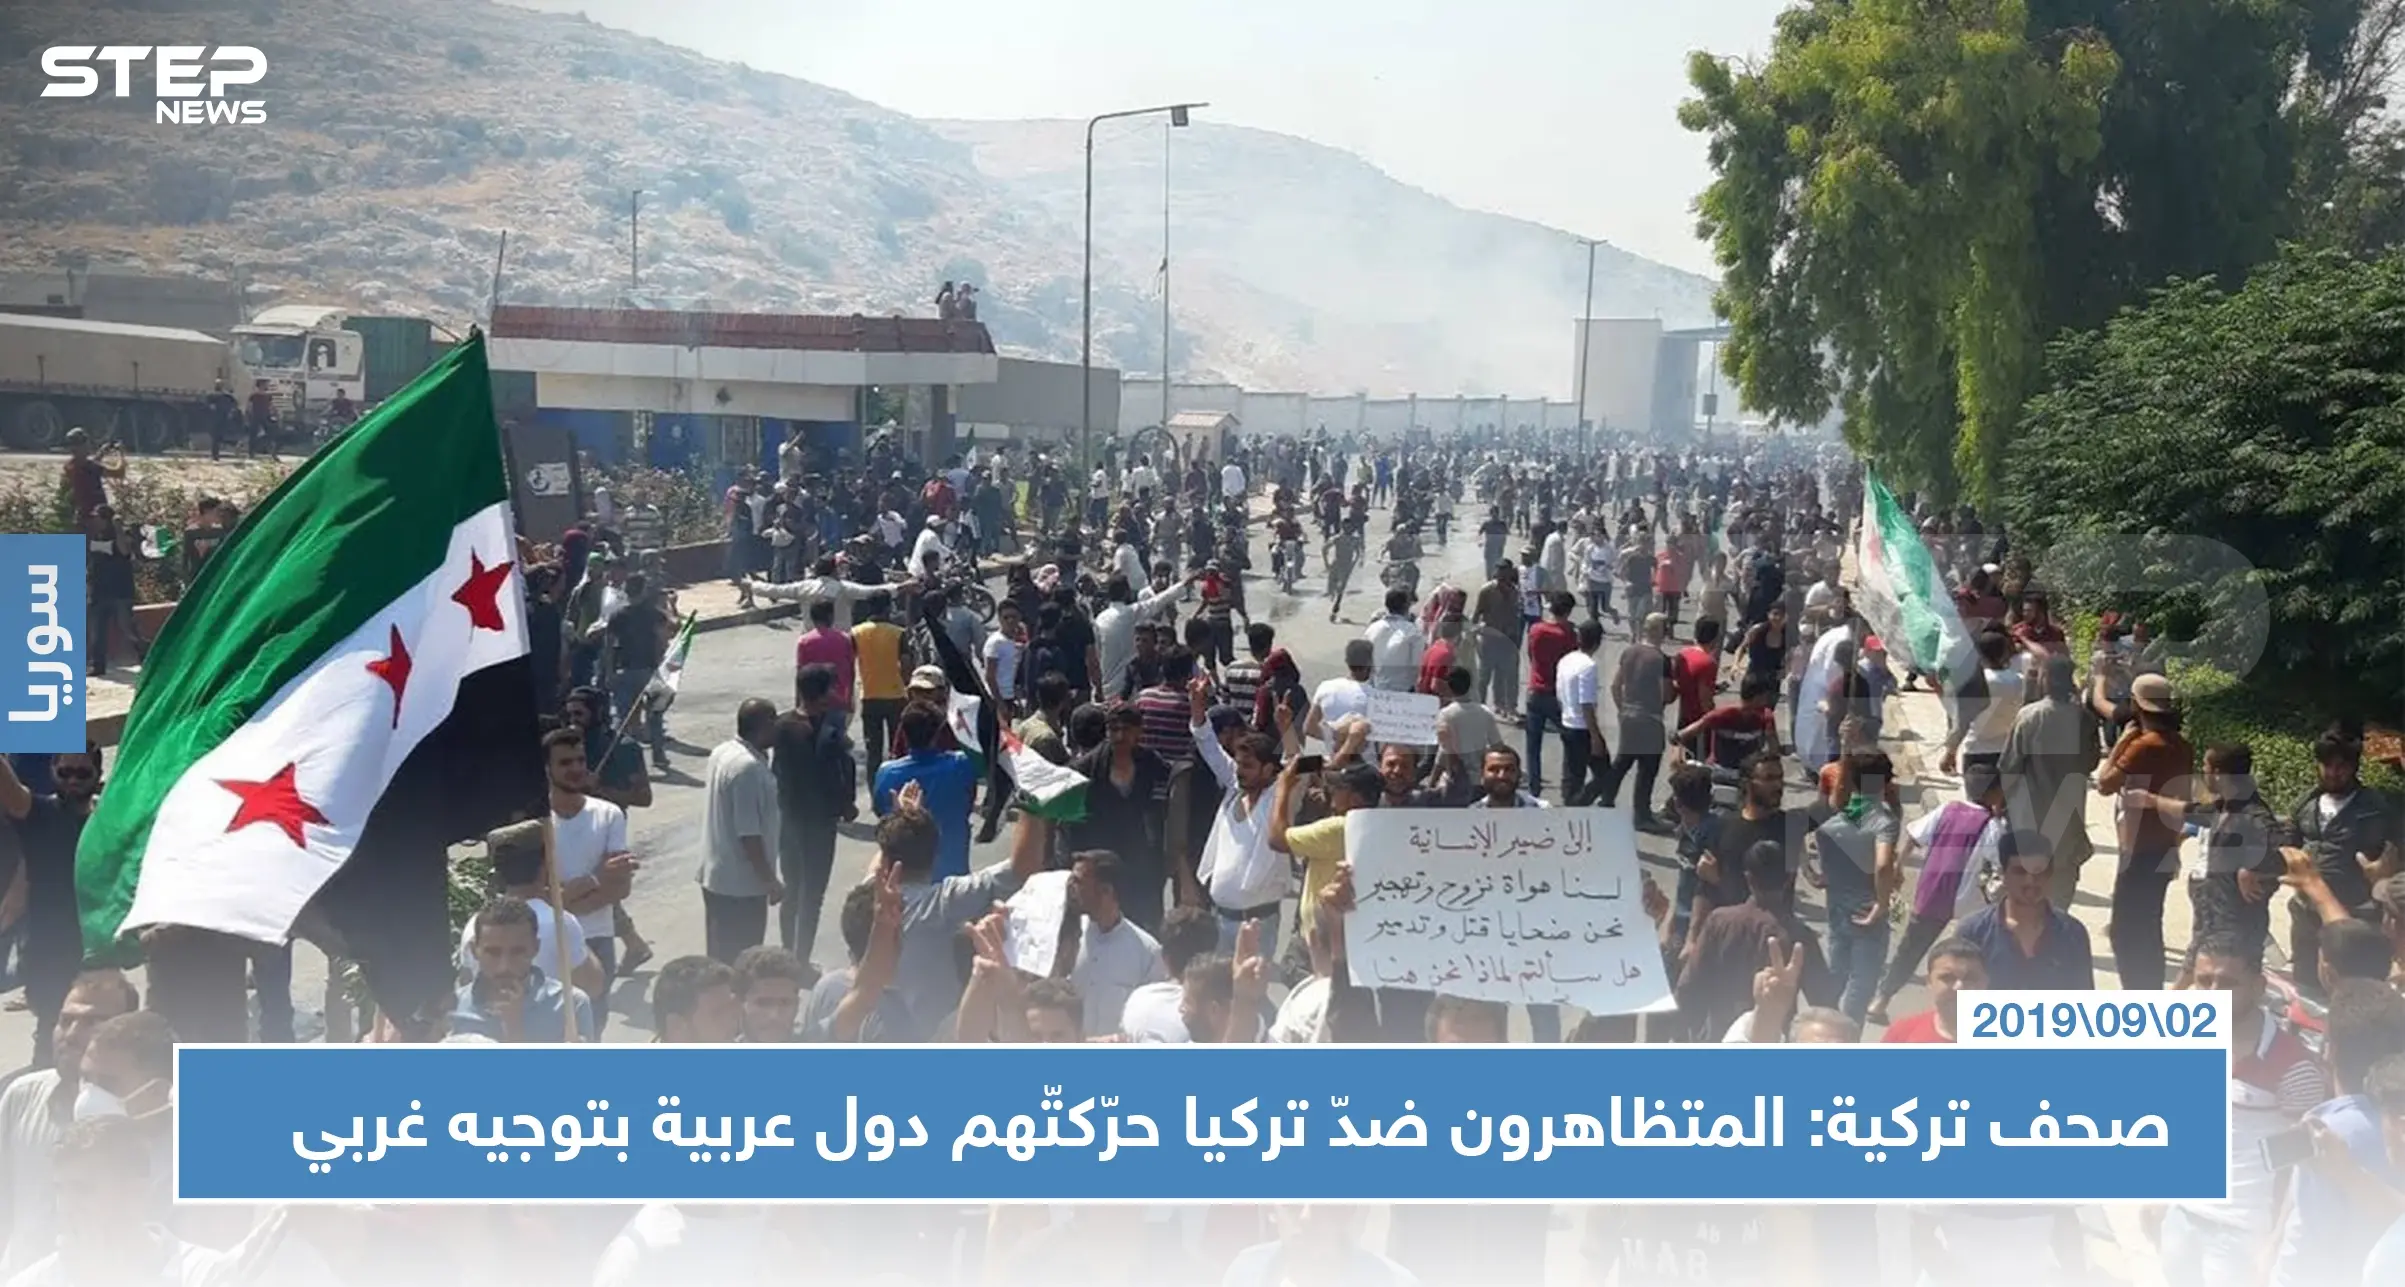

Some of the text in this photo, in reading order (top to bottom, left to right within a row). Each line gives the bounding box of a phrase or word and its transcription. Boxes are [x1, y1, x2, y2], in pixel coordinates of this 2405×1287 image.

[1501, 868, 1551, 902] هواة
[1452, 911, 1490, 945] قتل
[1583, 916, 1624, 944] نحن
[1612, 958, 1642, 987] هل
